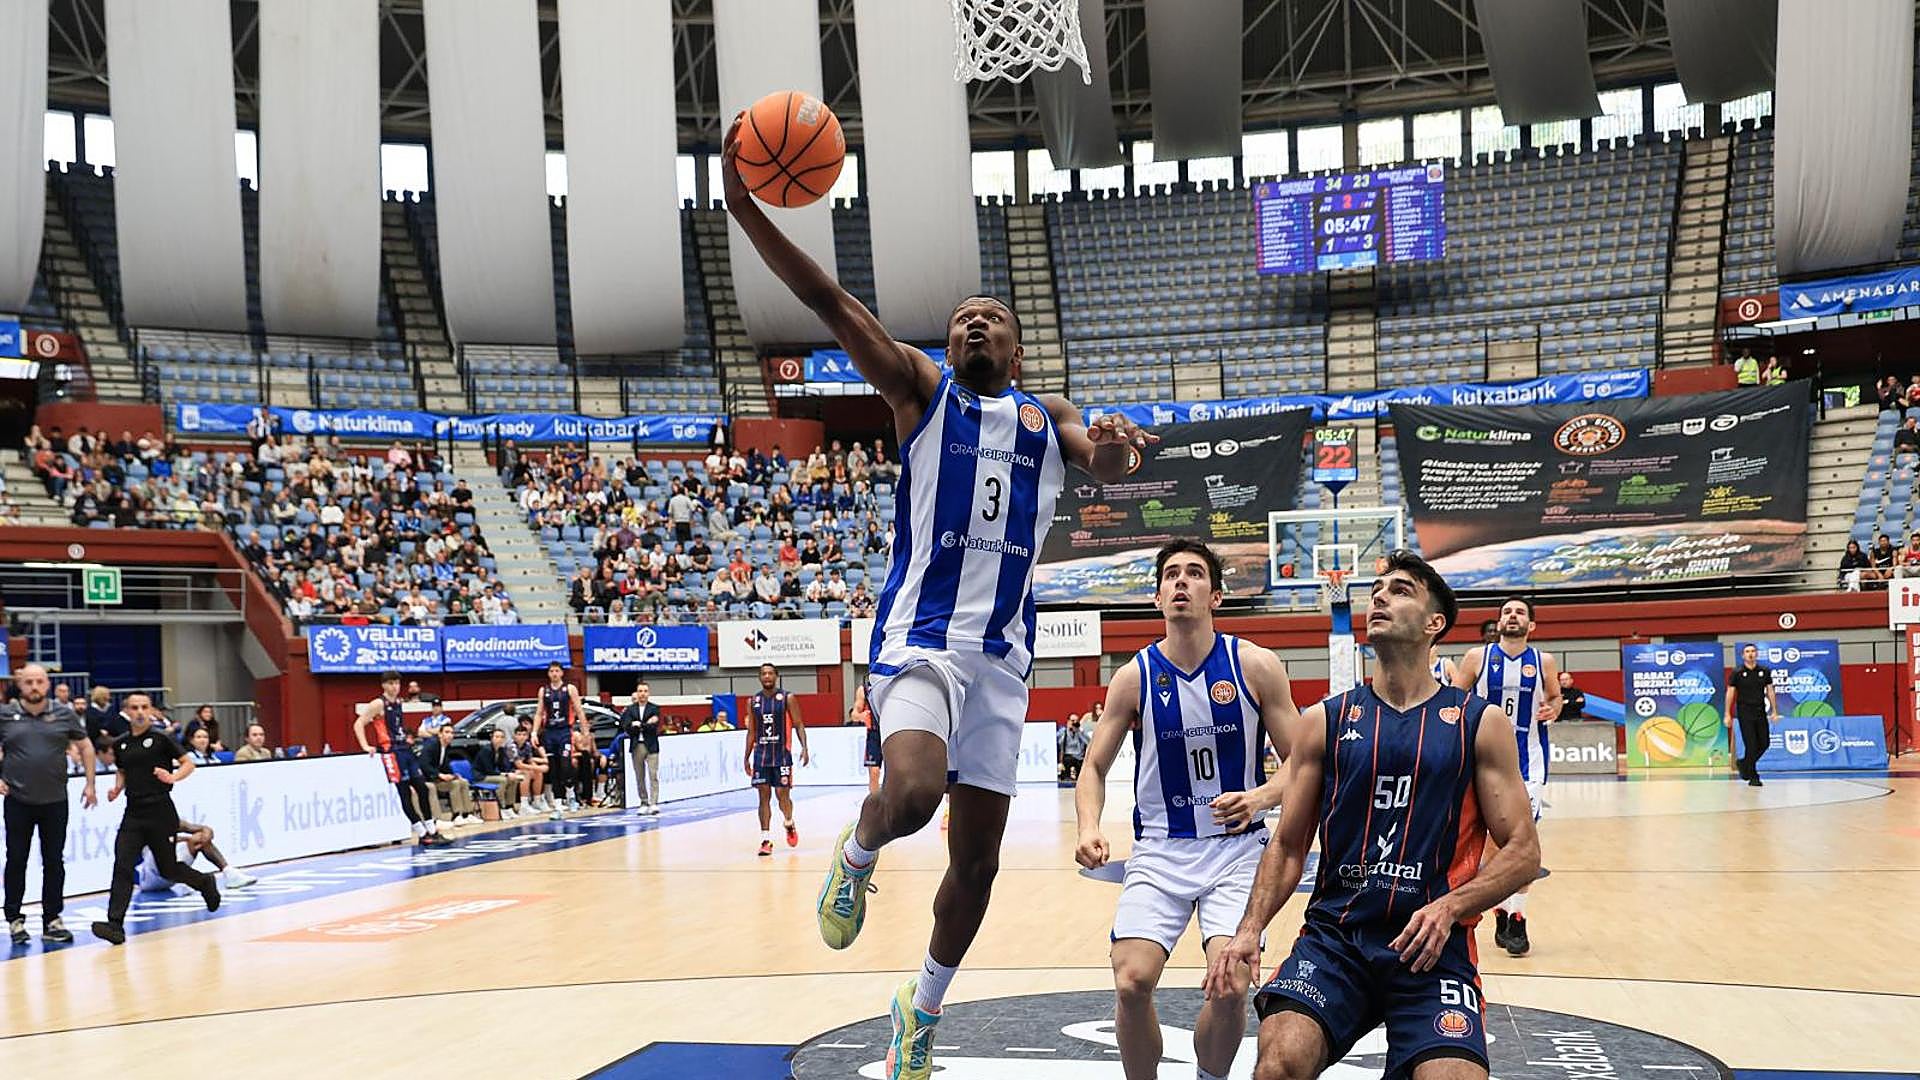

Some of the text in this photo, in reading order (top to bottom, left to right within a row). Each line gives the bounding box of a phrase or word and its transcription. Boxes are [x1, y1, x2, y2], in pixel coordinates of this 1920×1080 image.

[1325, 177, 1342, 191] 34
[1353, 174, 1370, 188] 23
[1324, 215, 1371, 234] 05:47
[1326, 237, 1334, 252] 1
[1363, 234, 1374, 249] 3
[1820, 280, 1920, 304] AMENABAR
[785, 363, 793, 376] 7
[1452, 381, 1557, 406] kutxabank
[318, 414, 413, 433] Naturklima
[459, 420, 535, 438] Invready
[1315, 428, 1355, 441] 05:47
[1444, 428, 1532, 441] Naturklima
[1317, 446, 1352, 469] 22
[1421, 459, 1490, 470] Aldaketa
[1421, 468, 1537, 476] eragin handiak
[1446, 484, 1519, 492] pequeños
[1483, 490, 1542, 498] pueden
[982, 477, 1001, 521] 3
[959, 534, 1029, 557] Naturklima
[1038, 618, 1087, 637] sonic
[390, 650, 438, 661] 404040
[593, 648, 699, 662] INDUSCREEN
[1660, 687, 1716, 696] RECICLANDO
[1505, 697, 1514, 717] 6
[763, 714, 773, 724] 55
[1550, 742, 1614, 762] bank
[780, 766, 790, 776] 55
[1190, 747, 1215, 781] 10
[1374, 775, 1412, 810] 50
[284, 786, 400, 832] kutxabank
[1439, 978, 1479, 1014] 50
